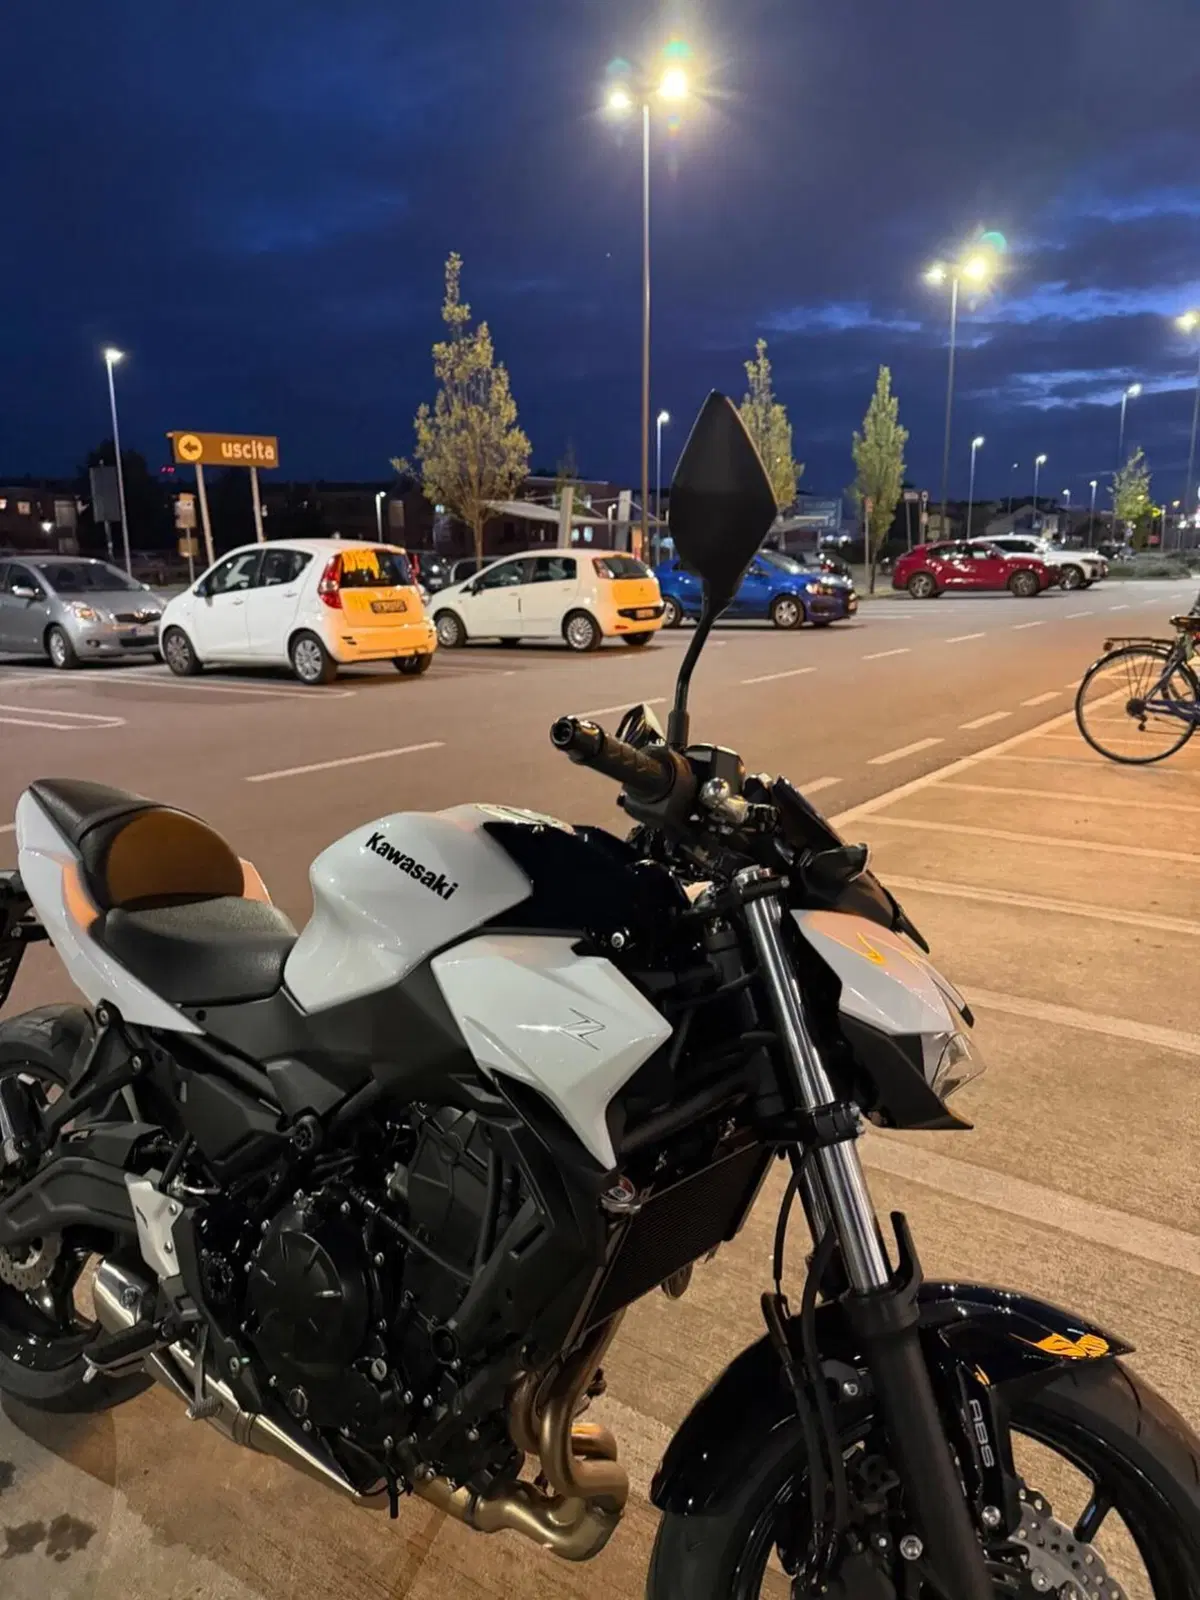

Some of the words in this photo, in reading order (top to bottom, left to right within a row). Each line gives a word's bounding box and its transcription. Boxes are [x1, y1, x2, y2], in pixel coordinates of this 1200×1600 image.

[221, 440, 275, 460] uscita
[365, 831, 459, 900] Kawasaki
[969, 1399, 995, 1468] ABS
